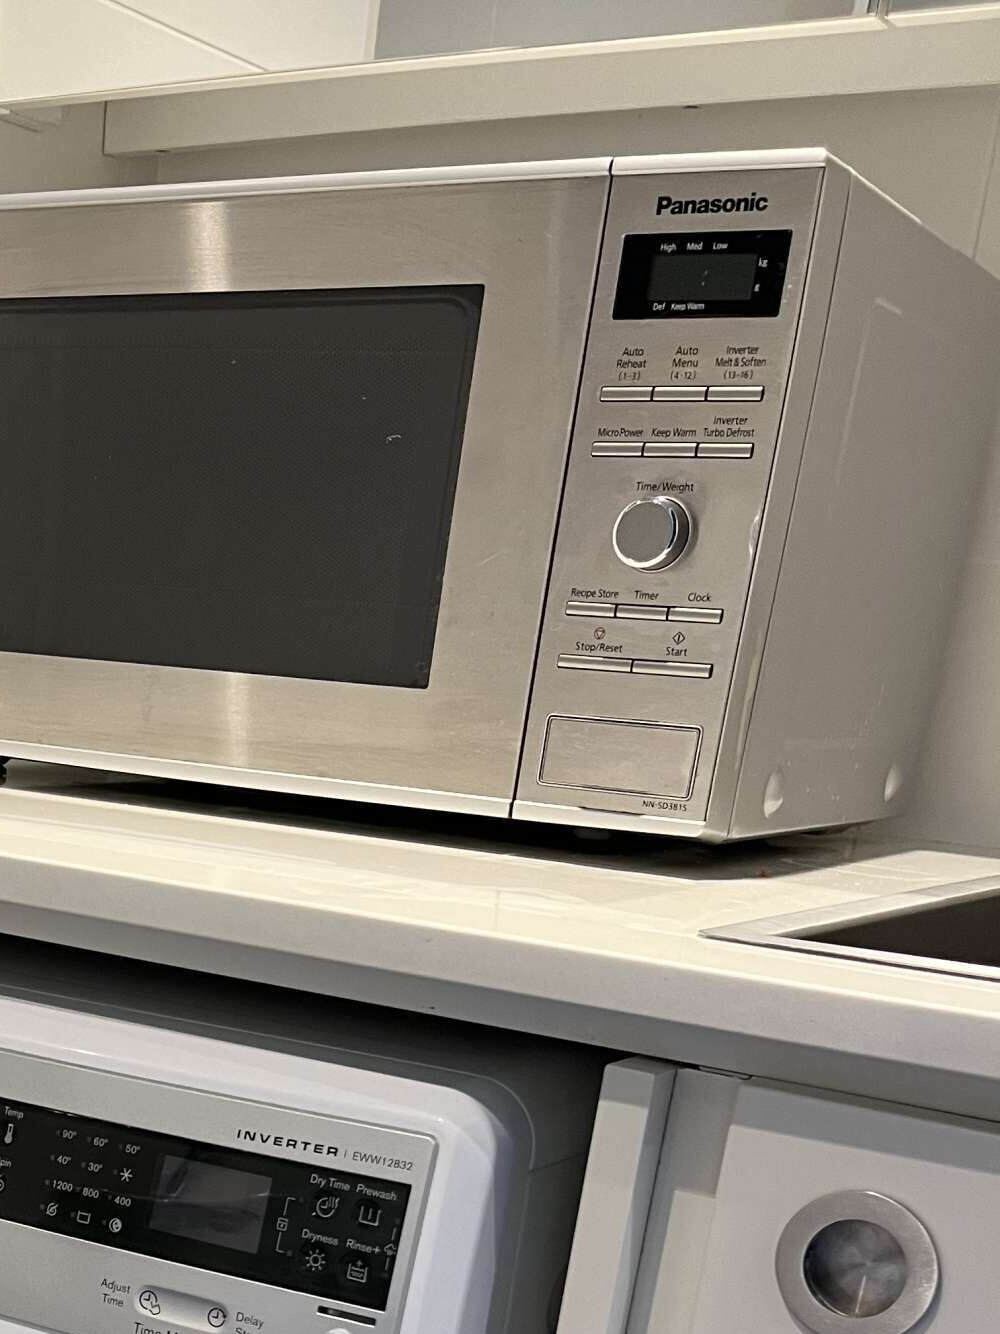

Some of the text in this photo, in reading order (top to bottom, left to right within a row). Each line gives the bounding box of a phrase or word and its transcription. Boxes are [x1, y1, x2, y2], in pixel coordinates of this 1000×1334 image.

[656, 192, 768, 215] Panasonic
[660, 242, 677, 252] High
[687, 241, 703, 251] Med
[712, 241, 728, 250] Low
[653, 302, 666, 311] Def
[671, 302, 686, 311] Keep
[622, 347, 644, 357] Auto
[675, 346, 699, 356] Auto
[726, 345, 760, 355] Inverter
[616, 358, 647, 369] Reheat
[672, 358, 698, 368] Menu
[715, 357, 732, 367] Melt
[740, 357, 767, 367] Soften
[713, 415, 748, 425] Inverter
[651, 426, 697, 438] Keep Warm
[704, 427, 754, 438] Turbo Defrost
[636, 481, 694, 492] Time/Weight
[571, 588, 619, 598] Recipe Store
[635, 591, 659, 600] Timer
[688, 592, 712, 602] Clock
[575, 642, 623, 653] Stop/Reset
[666, 647, 687, 657] Start
[4, 1106, 24, 1120] Temp
[237, 1129, 414, 1172] INVERTER EWW12832
[52, 1179, 73, 1192] 1200
[310, 1173, 350, 1192] Dry Time
[356, 1184, 397, 1201] Prewash
[114, 1196, 132, 1207] 400
[302, 1229, 338, 1246] Dryness
[100, 1278, 131, 1295] Adjust
[102, 1294, 124, 1308] Time
[235, 1312, 265, 1330] Delay
